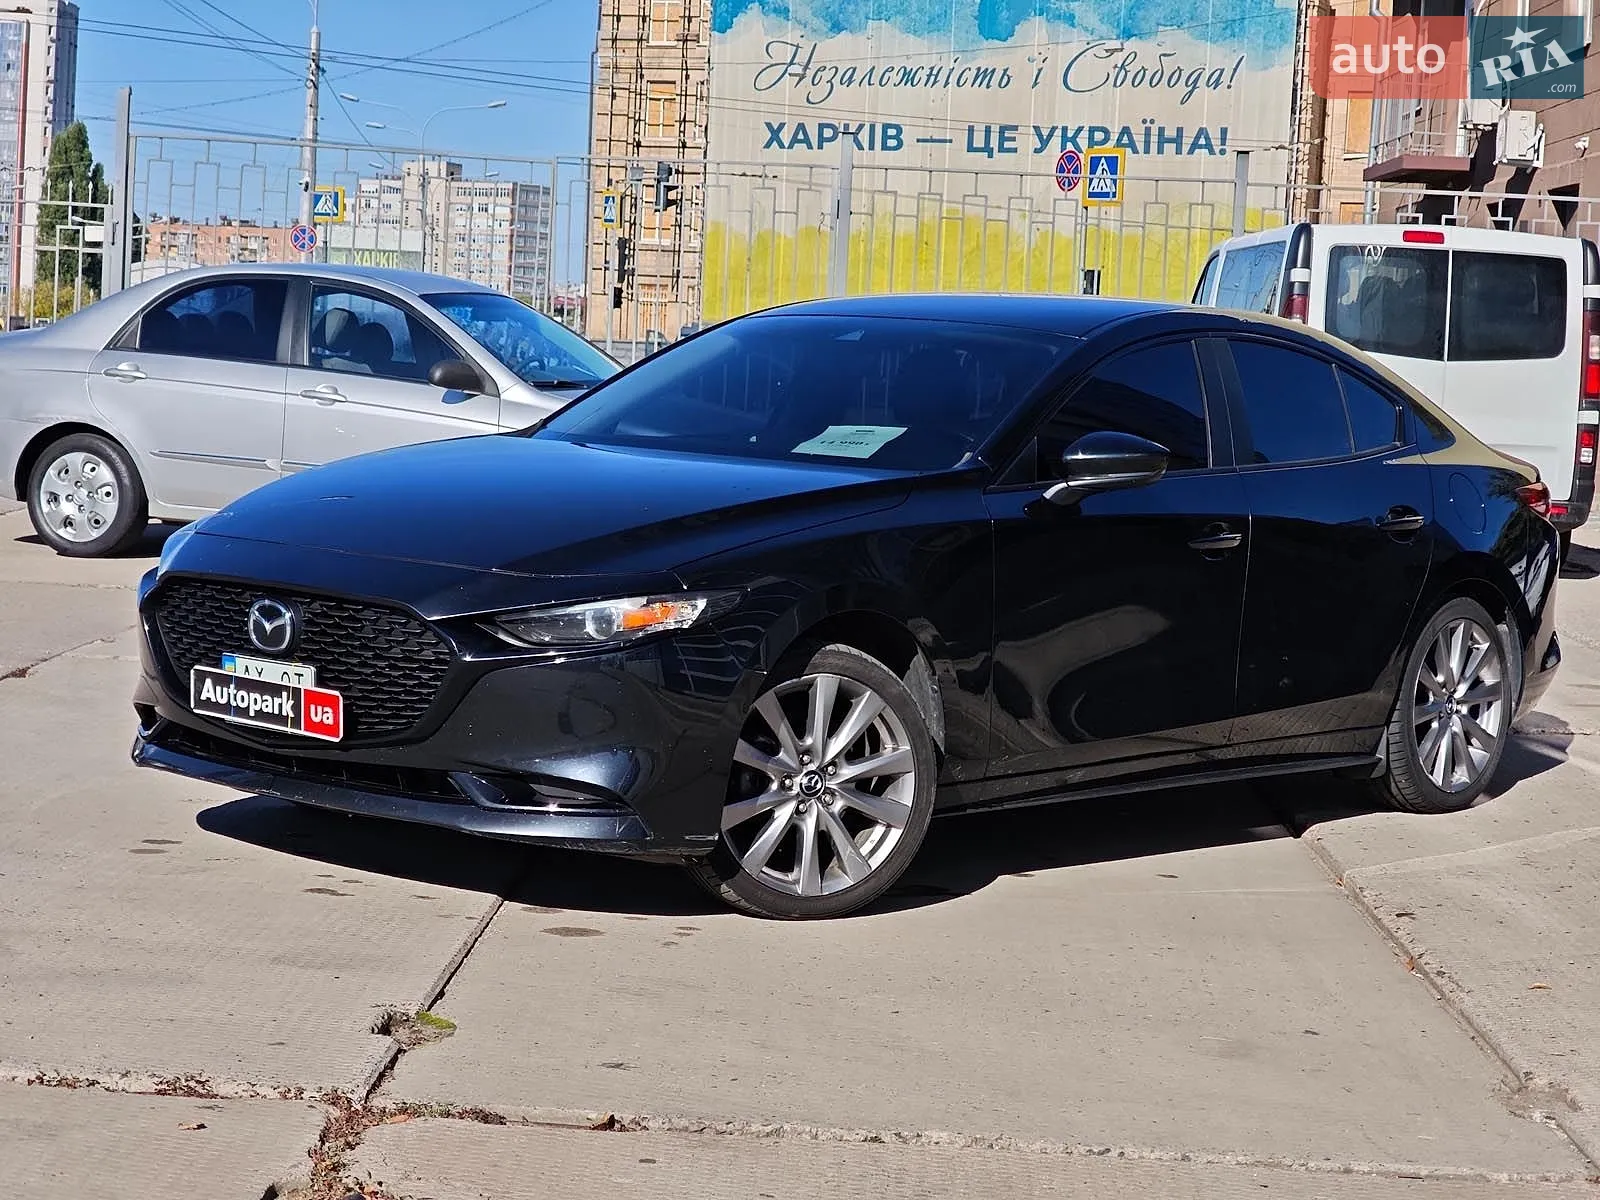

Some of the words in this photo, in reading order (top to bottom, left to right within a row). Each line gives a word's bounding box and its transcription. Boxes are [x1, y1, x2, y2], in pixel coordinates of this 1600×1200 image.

[753, 40, 1013, 105] Незалежність
[1063, 41, 1246, 105] Свобода!
[762, 121, 904, 152] ХАРКІВ
[966, 124, 1019, 159] ЦЕ
[1032, 118, 1228, 156] УКРАЇНА!
[201, 678, 295, 717] Autopark
[310, 704, 334, 725] ua
